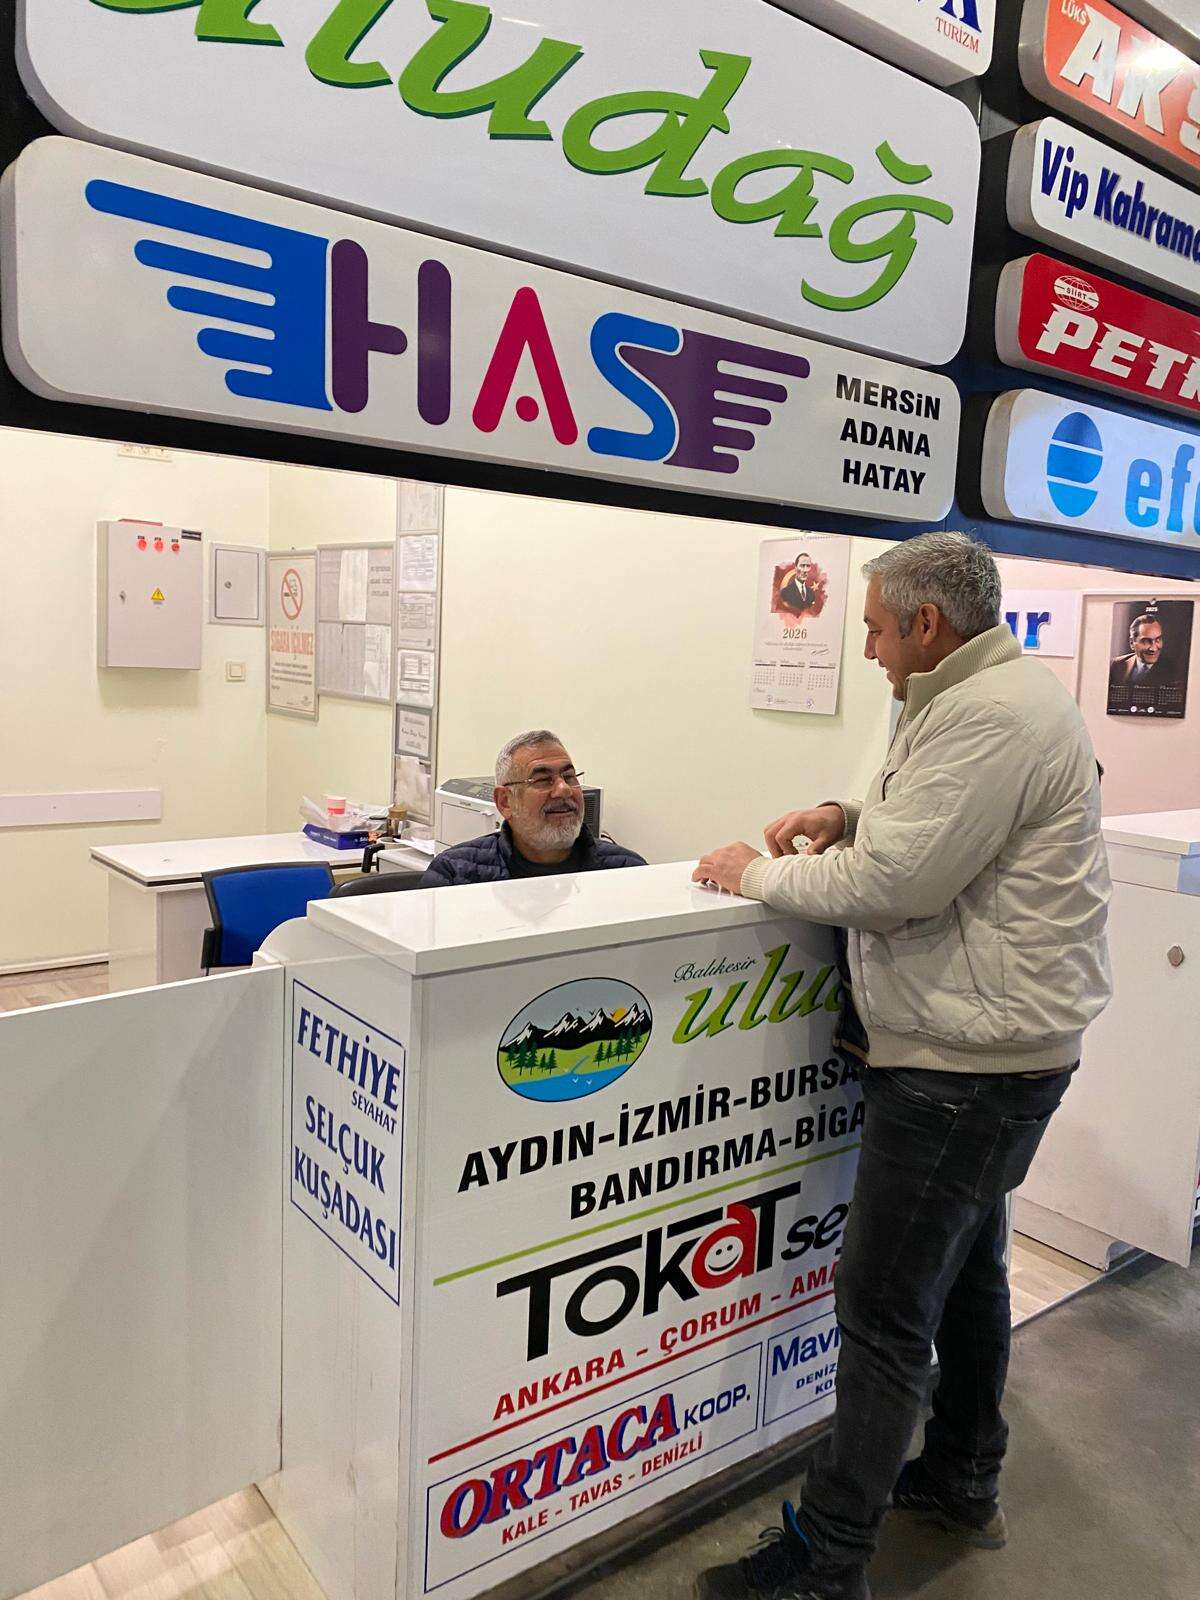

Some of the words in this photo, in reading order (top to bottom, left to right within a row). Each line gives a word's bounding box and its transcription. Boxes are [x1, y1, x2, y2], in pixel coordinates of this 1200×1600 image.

[936, 17, 979, 54] TURİZM
[1041, 138, 1089, 219] Vip
[331, 239, 681, 464] HAS
[840, 417, 931, 458] ADANA
[842, 458, 926, 495] HATAY
[1125, 443, 1200, 535] ef
[782, 627, 807, 640] 2026
[297, 1006, 401, 1112] FETHİYE
[305, 1095, 385, 1194] SELÇUK
[351, 1089, 398, 1136] SEYAHAT
[570, 1100, 866, 1220] BANDIRMA-BİGA
[294, 1145, 396, 1271] KUŞADASI
[493, 1348, 626, 1421] ANKARA
[660, 1292, 762, 1357] ÇORUM
[440, 1393, 681, 1539] ORTACA
[684, 1383, 750, 1430] KOOP.
[502, 1508, 549, 1545] KALE
[569, 1473, 623, 1513] TAVAS
[641, 1431, 703, 1478] DENİZLİ
